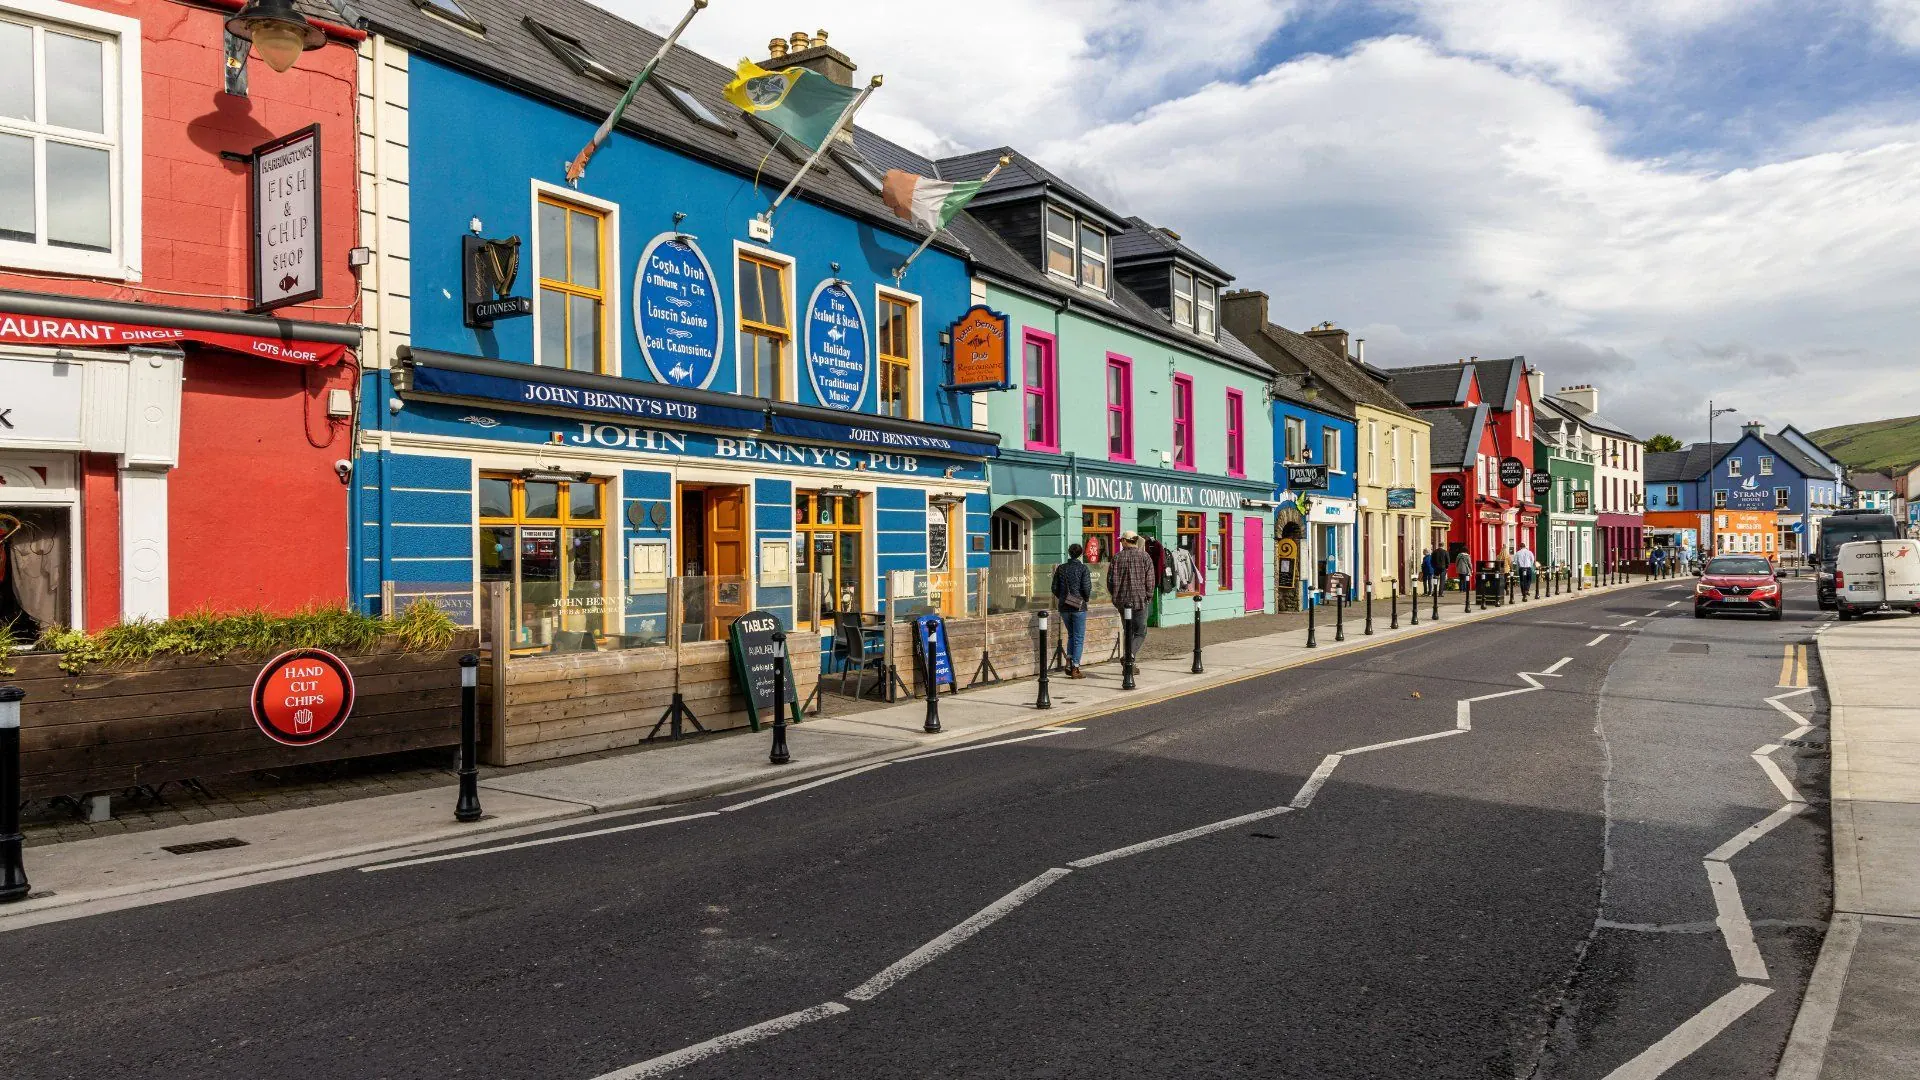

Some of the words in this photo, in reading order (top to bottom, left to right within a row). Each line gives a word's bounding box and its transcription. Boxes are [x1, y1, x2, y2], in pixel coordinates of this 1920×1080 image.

[262, 144, 312, 174] HARRINGTON'S
[268, 168, 306, 202] FISH
[284, 201, 292, 216] &
[267, 216, 308, 247] CHIP
[272, 248, 304, 271] SHOP
[476, 300, 516, 316] GUINNESS
[830, 298, 844, 312] Fine
[0, 317, 115, 340] AURANT
[122, 330, 184, 340] DINGLE
[814, 308, 835, 324] Seafood
[836, 314, 842, 326] &
[842, 315, 859, 329] Steaks
[252, 341, 280, 356] LOTS
[824, 342, 850, 360] Holiday
[812, 352, 863, 372] Apartments
[819, 375, 859, 392] Traditional
[525, 384, 579, 404] JOHN
[584, 391, 662, 415] BENNY'S
[666, 402, 698, 420] PUB
[828, 390, 850, 402] Music
[572, 423, 688, 452] JOHN
[714, 438, 850, 468] BENNY'S
[868, 452, 918, 472] PUB
[849, 428, 881, 442] JOHN
[882, 432, 930, 448] BENNY'S
[930, 436, 950, 449] PUB
[1051, 474, 1080, 497] THE
[1086, 476, 1134, 501] DINGLE
[1141, 482, 1194, 506] WOOLLEN
[1200, 488, 1243, 509] COMPANY
[1733, 490, 1769, 498] STRAND
[552, 598, 584, 608] JOHN
[586, 596, 634, 606] BENN'S
[742, 618, 775, 633] TABLES
